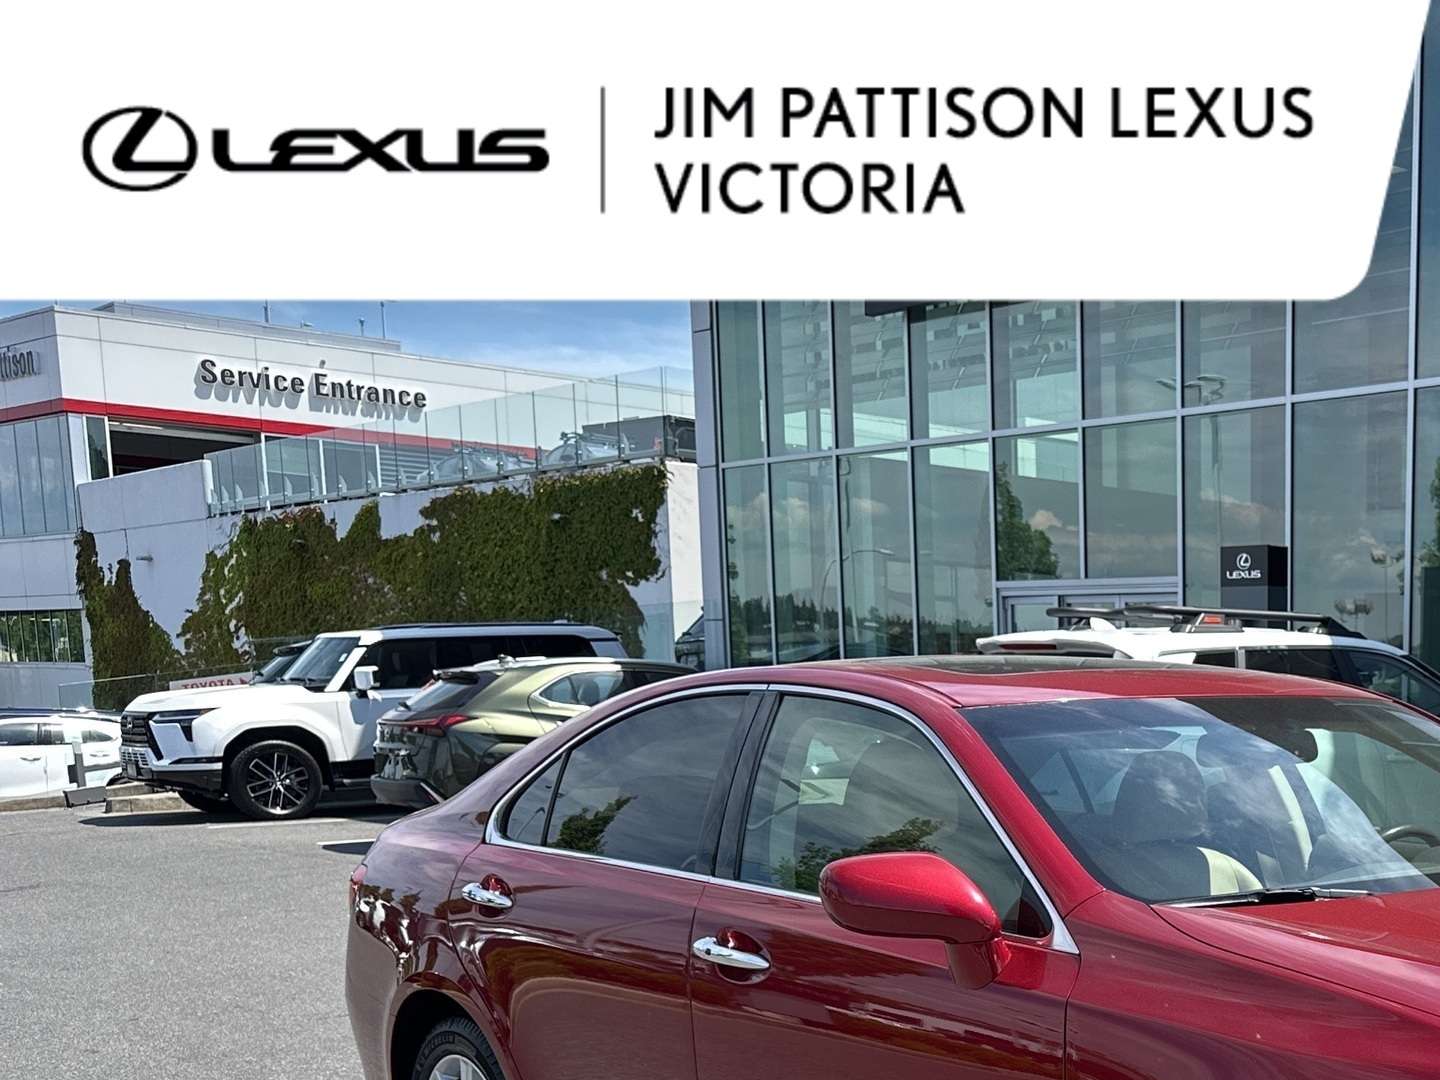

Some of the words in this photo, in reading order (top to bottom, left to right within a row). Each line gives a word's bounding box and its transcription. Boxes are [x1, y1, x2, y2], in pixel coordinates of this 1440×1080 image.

[200, 358, 305, 394] Service
[313, 372, 428, 409] Entrance
[1226, 569, 1262, 580] LEXUS
